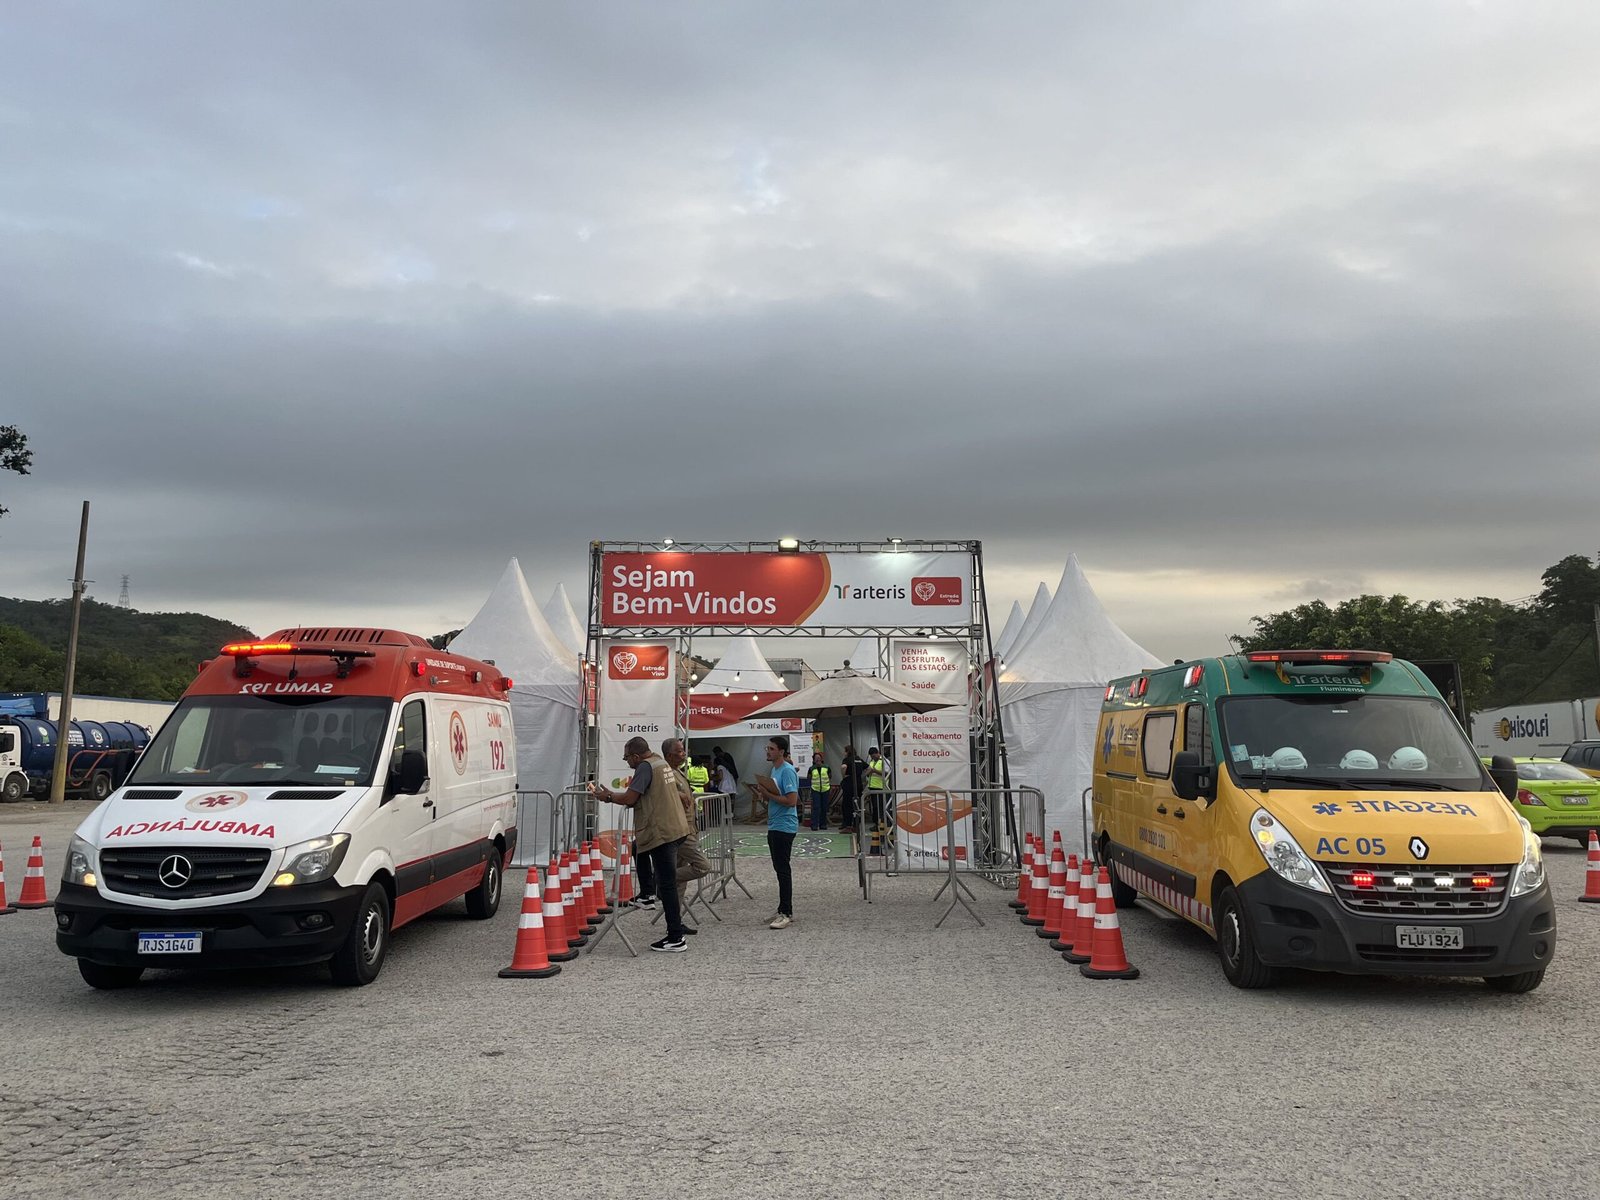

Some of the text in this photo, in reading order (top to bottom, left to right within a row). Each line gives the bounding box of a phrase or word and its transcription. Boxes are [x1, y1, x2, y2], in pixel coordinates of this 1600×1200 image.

[612, 565, 694, 593] Sejam
[853, 585, 906, 599] arteris
[612, 591, 777, 614] Bem-Vindos
[918, 663, 959, 672] ESTAÇÕES:
[911, 681, 936, 689] Saúde
[1310, 674, 1362, 685] arteris
[487, 711, 502, 728] SAMU
[627, 723, 659, 733] arteris
[756, 722, 779, 730] arteris
[912, 732, 962, 740] Relaxamento
[489, 740, 505, 770] 192
[912, 749, 951, 758] Educação
[913, 766, 934, 774] Lazer
[1316, 837, 1386, 856] AC 05
[143, 939, 194, 952] RJS1G40
